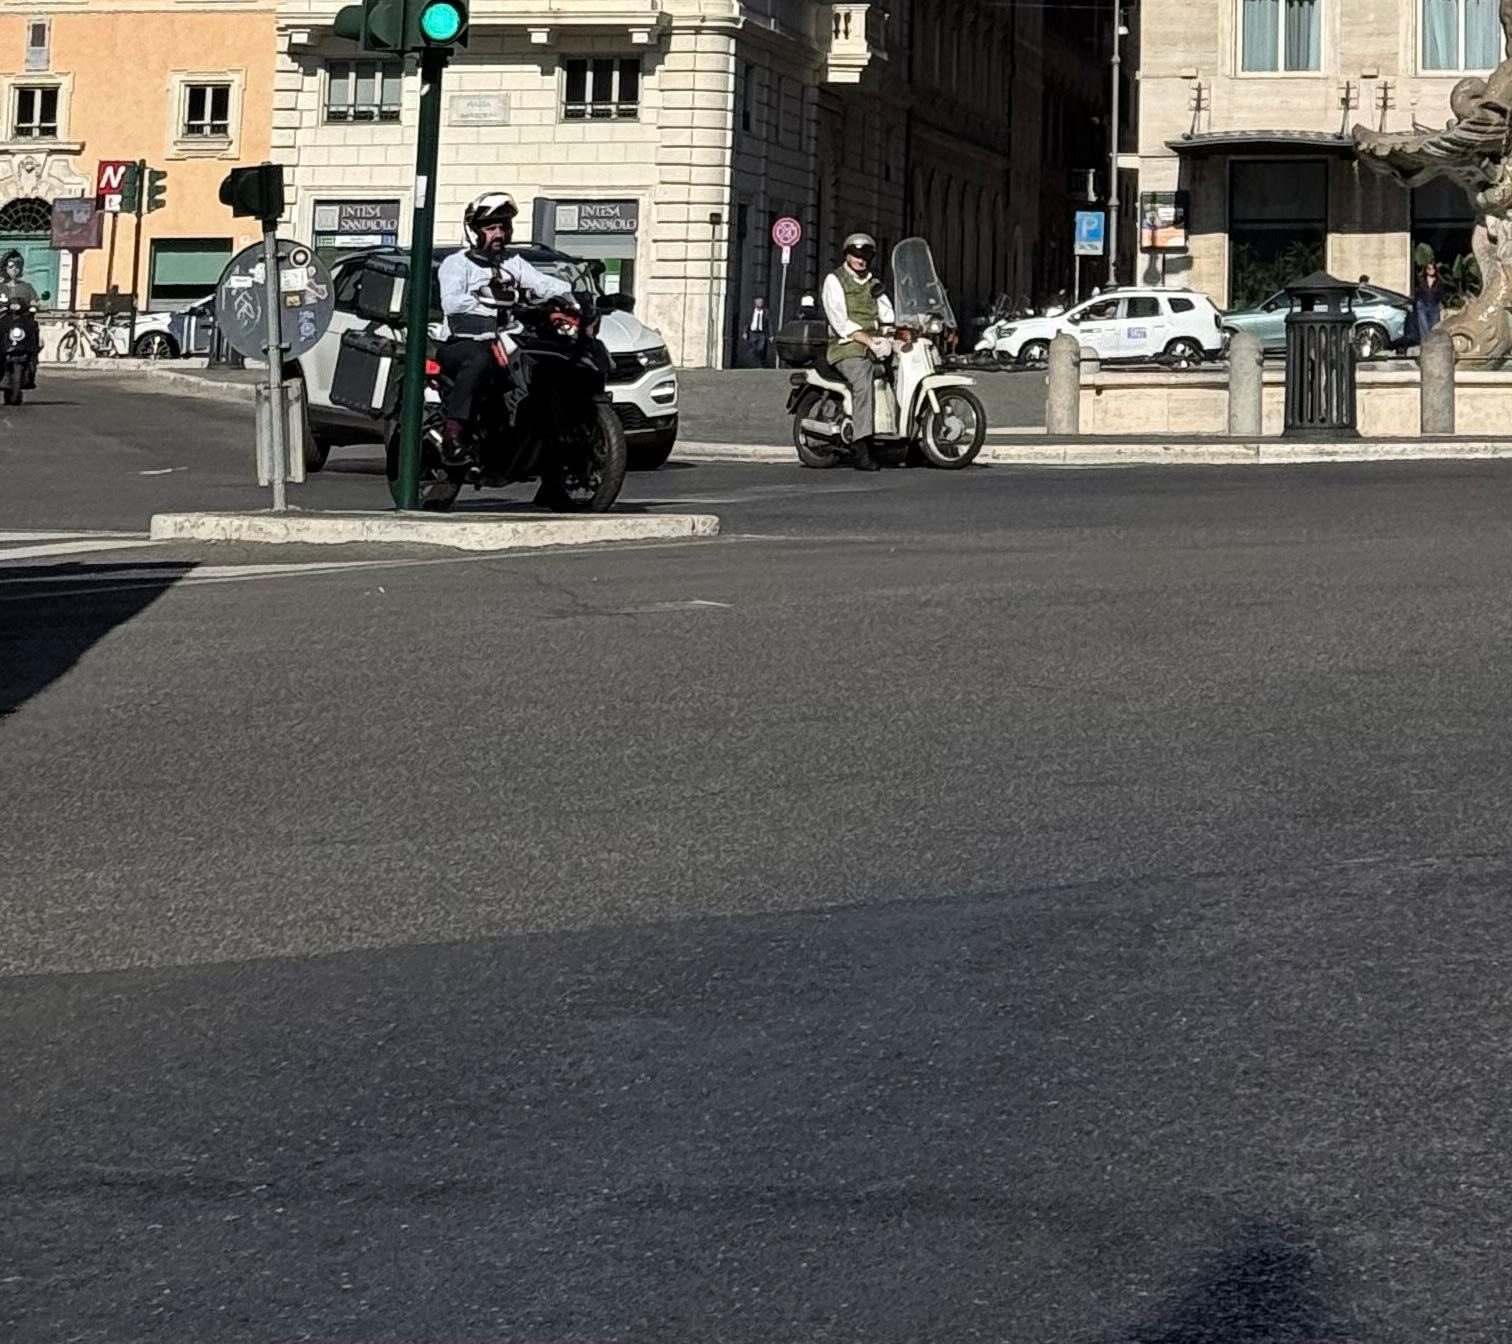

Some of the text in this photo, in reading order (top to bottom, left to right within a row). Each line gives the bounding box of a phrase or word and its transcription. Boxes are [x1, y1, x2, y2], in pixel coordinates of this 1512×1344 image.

[342, 204, 381, 218] INTESA
[580, 204, 620, 218] INTESA
[1081, 215, 1099, 238] P
